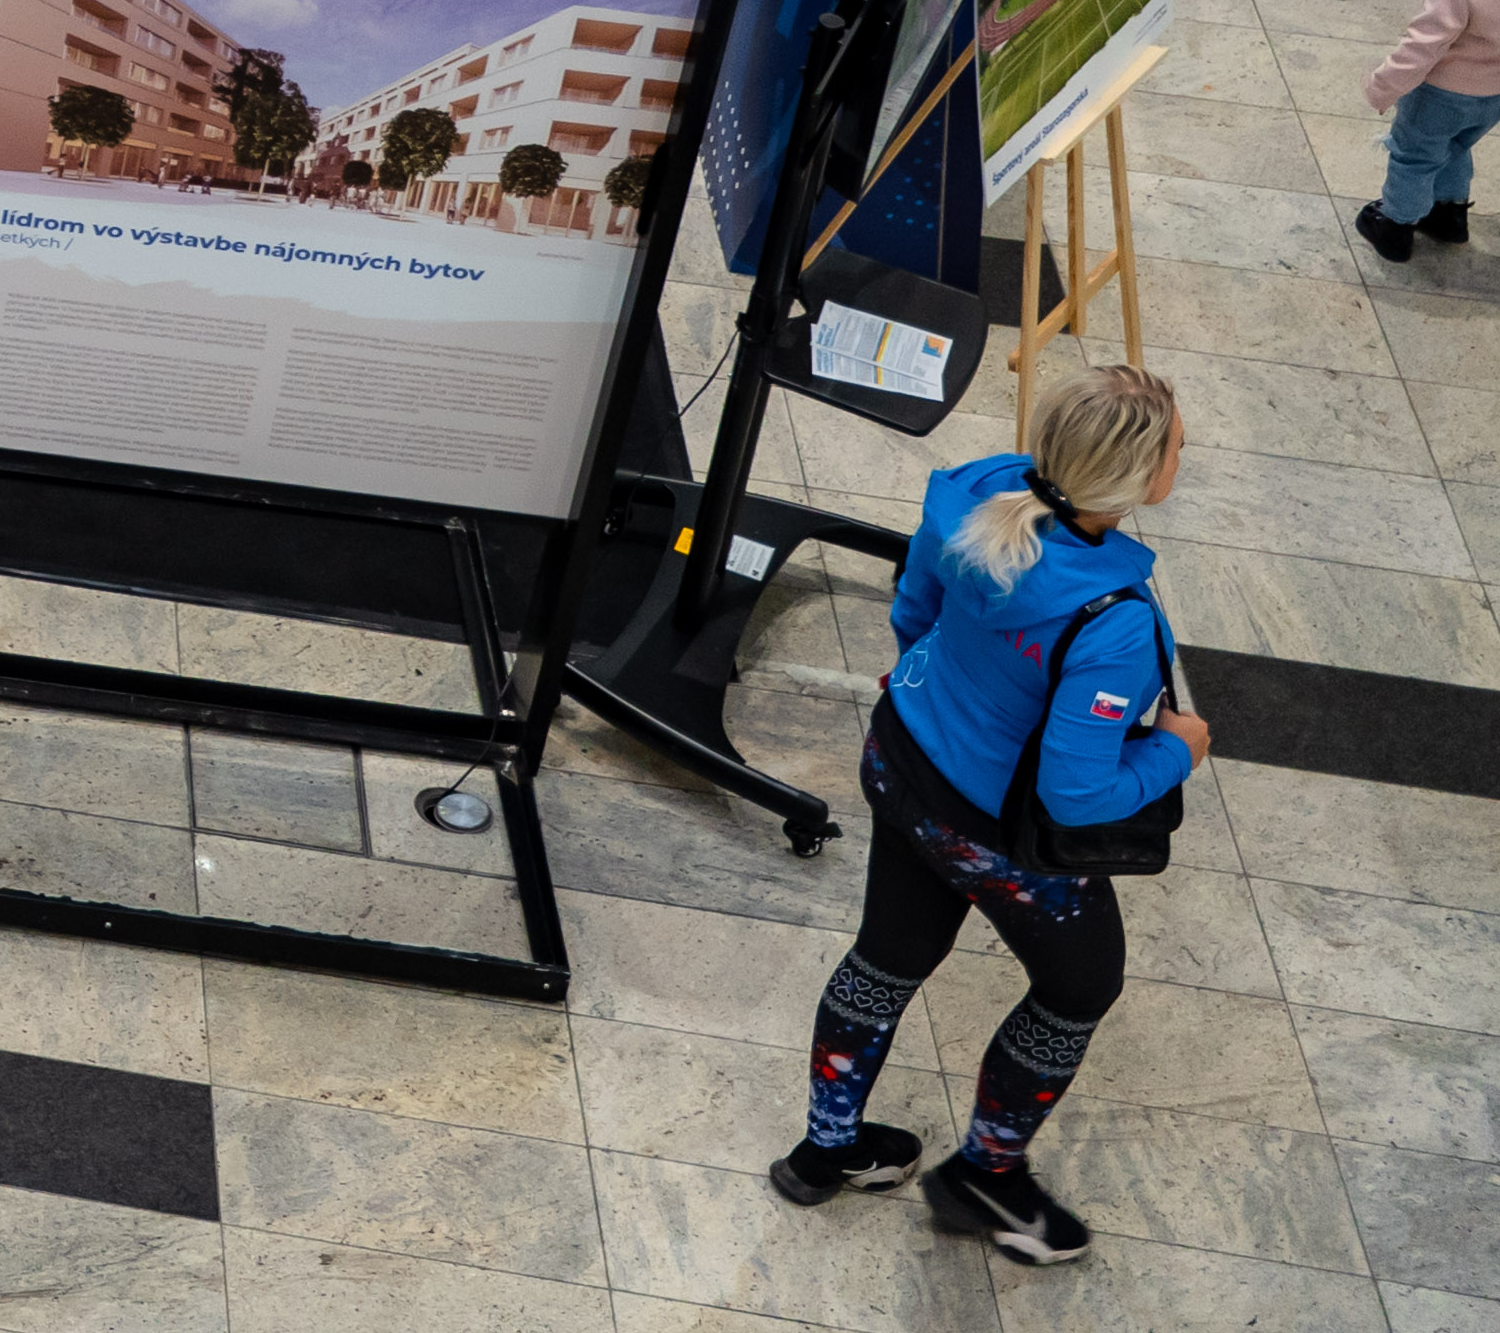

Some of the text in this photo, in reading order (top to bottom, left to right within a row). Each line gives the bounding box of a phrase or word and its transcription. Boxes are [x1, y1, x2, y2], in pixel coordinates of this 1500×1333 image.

[1, 209, 85, 235] lídrom
[92, 224, 124, 239] vo
[130, 225, 248, 253] výstavbe
[254, 239, 401, 273] nájomných
[408, 258, 485, 282] bytov
